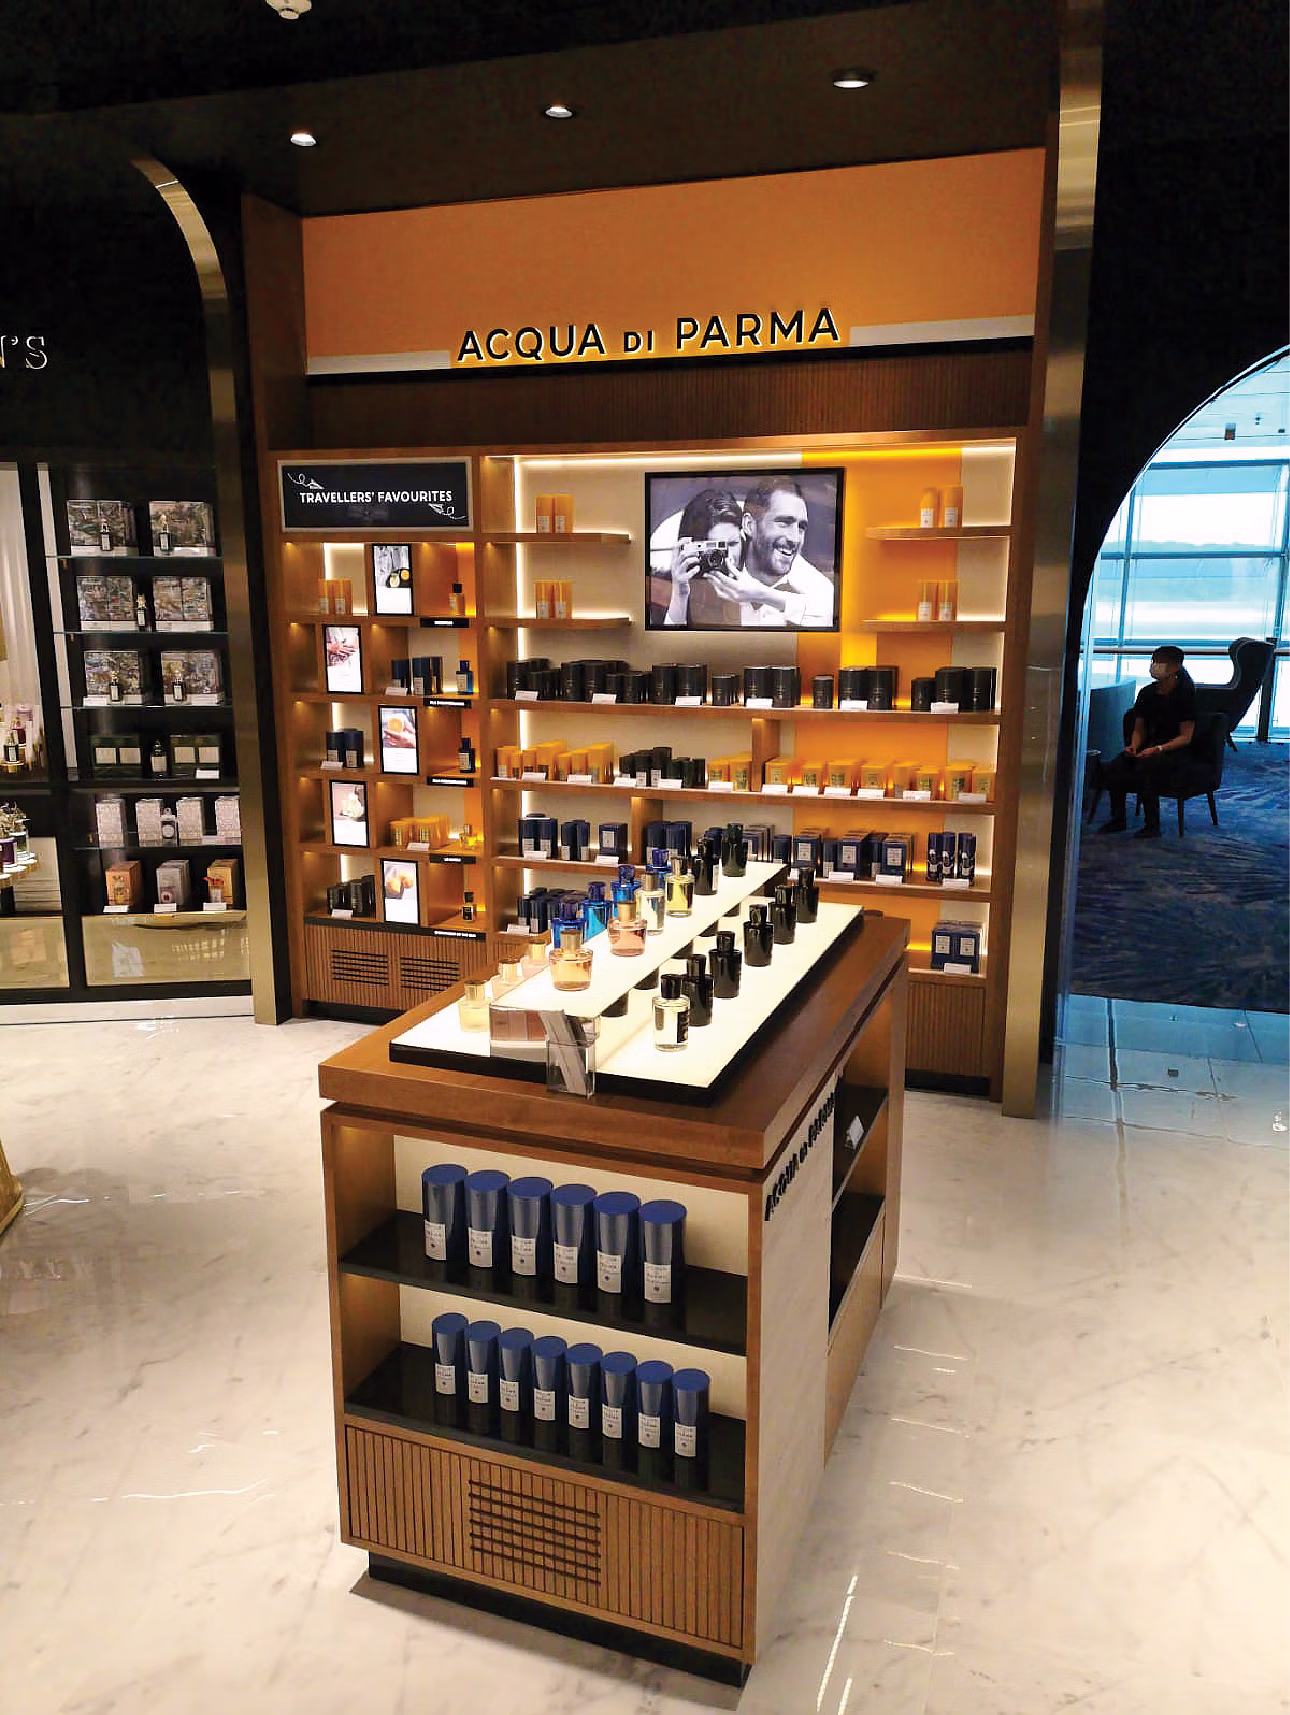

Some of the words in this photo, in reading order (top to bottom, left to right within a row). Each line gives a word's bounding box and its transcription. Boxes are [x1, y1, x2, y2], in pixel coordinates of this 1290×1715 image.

[457, 324, 607, 362] ACQUA
[624, 330, 656, 354] DI
[676, 308, 841, 352] PARMA
[300, 491, 375, 504] TRAVELLERS'
[377, 490, 453, 503] FAVOURITES
